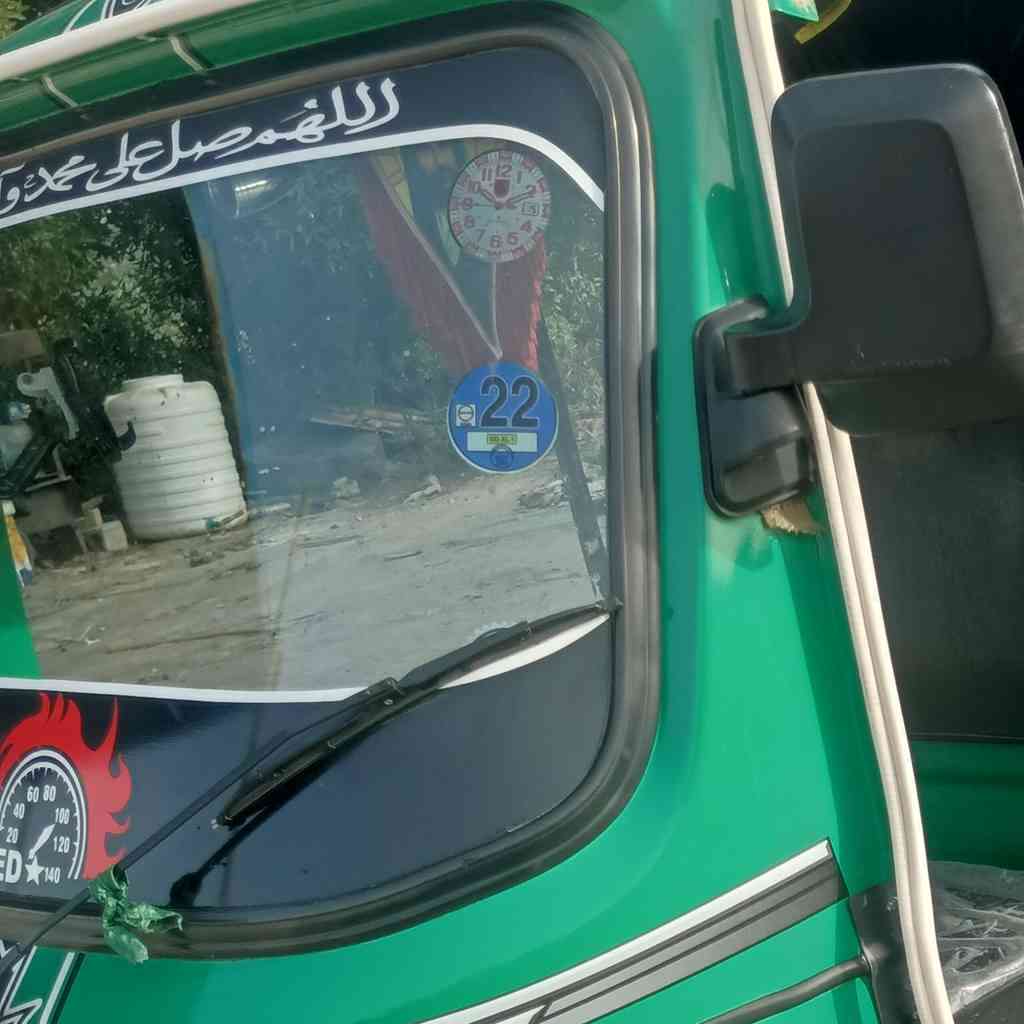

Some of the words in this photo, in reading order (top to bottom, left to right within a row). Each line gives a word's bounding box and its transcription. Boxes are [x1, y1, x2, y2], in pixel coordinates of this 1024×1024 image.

[480, 375, 540, 429] 22
[26, 786, 40, 802] 60
[43, 785, 56, 802] 80
[13, 803, 25, 819] 40
[55, 808, 70, 825] 100
[5, 827, 19, 844] 20
[53, 836, 70, 853] 120
[44, 867, 61, 884] 140
